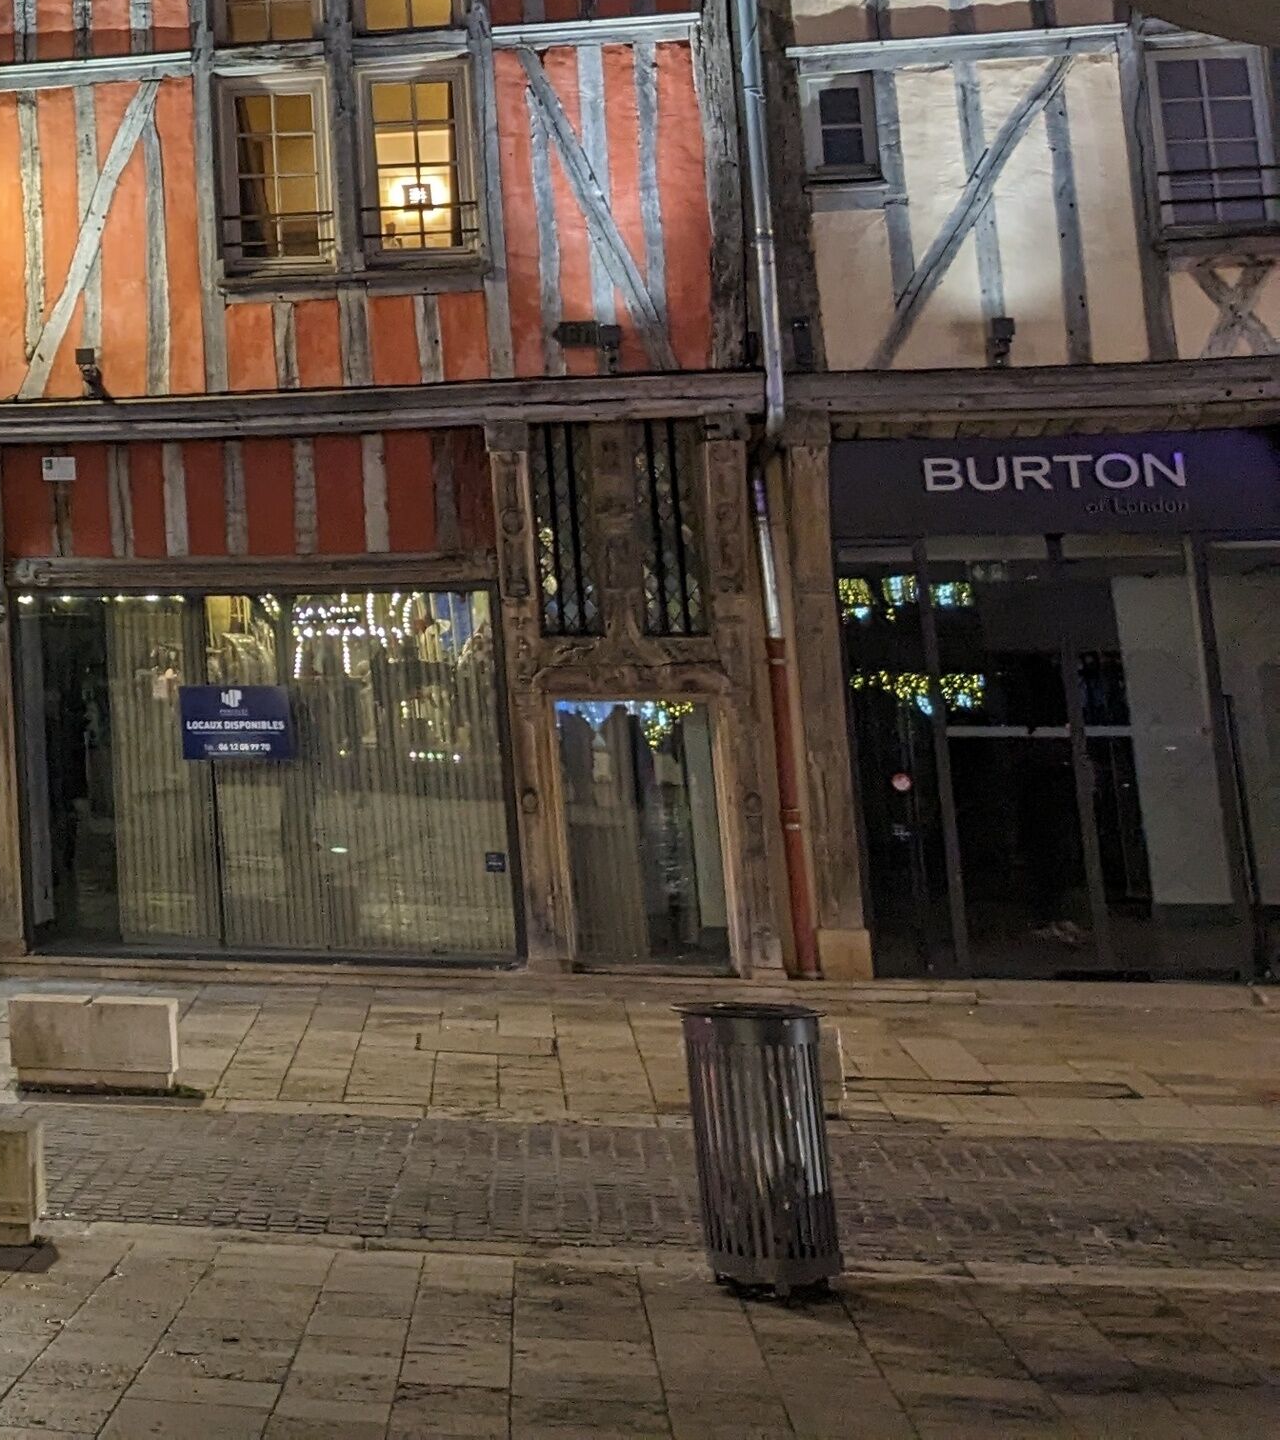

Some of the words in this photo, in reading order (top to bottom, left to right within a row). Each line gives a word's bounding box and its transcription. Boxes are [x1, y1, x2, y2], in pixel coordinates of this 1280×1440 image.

[923, 452, 1186, 491] BURTON
[1113, 496, 1191, 515] London
[186, 720, 223, 730] LOCAUX
[224, 720, 285, 730] DISPONIBLES
